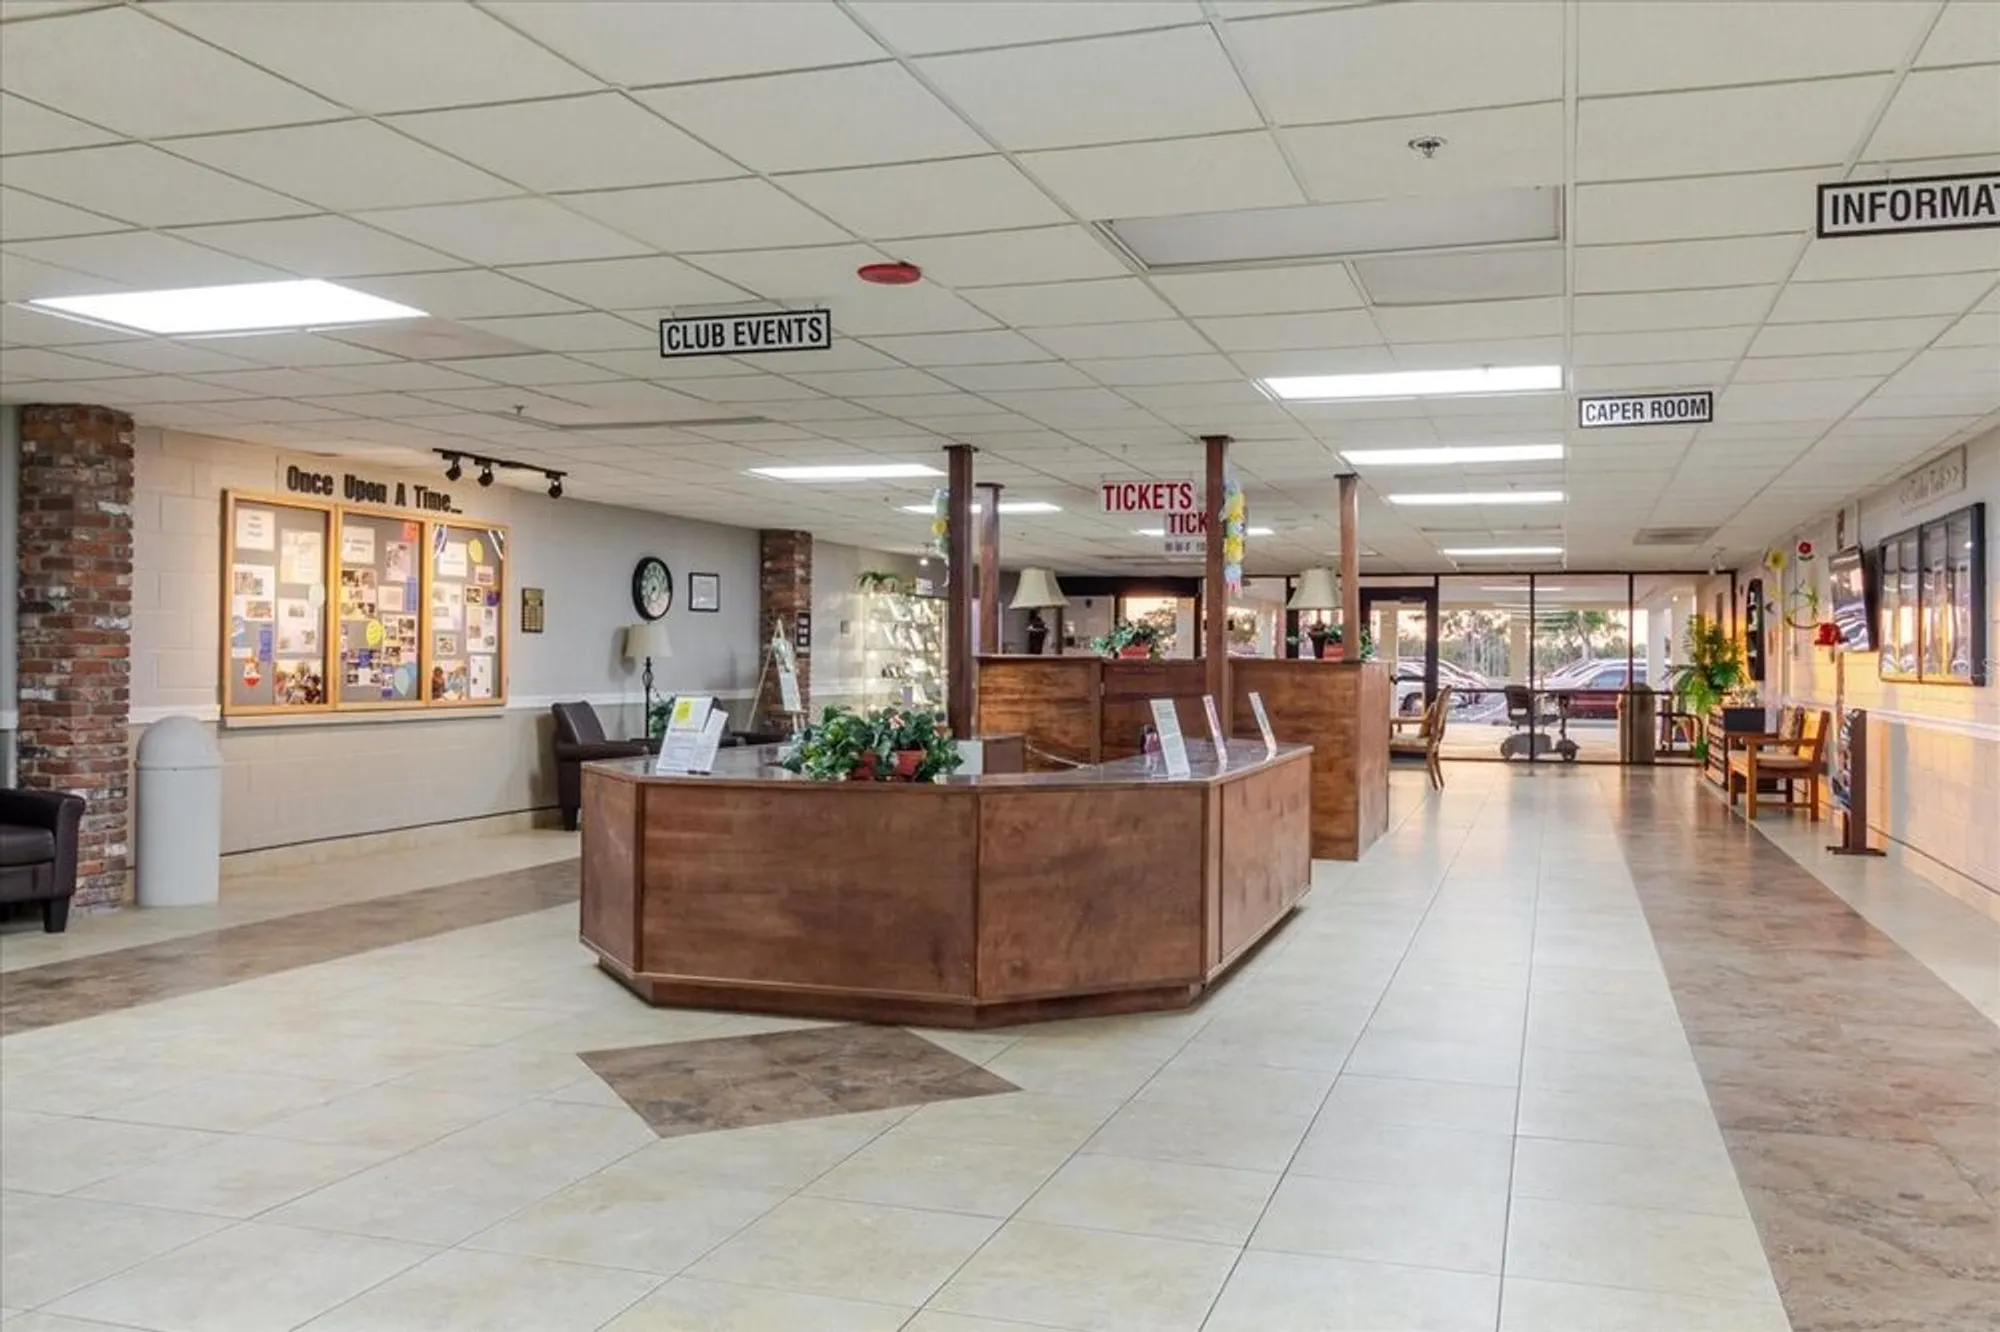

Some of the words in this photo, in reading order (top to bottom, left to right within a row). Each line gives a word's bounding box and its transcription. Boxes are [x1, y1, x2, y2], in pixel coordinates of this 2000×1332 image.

[667, 322, 725, 351] CLUB
[734, 316, 822, 346] EVENTS
[1586, 402, 1644, 421] CAPER
[1650, 398, 1707, 418] ROOM
[286, 465, 334, 496] Once
[344, 474, 387, 503] Upon
[395, 482, 407, 507] A
[1102, 483, 1192, 511] TICKETS
